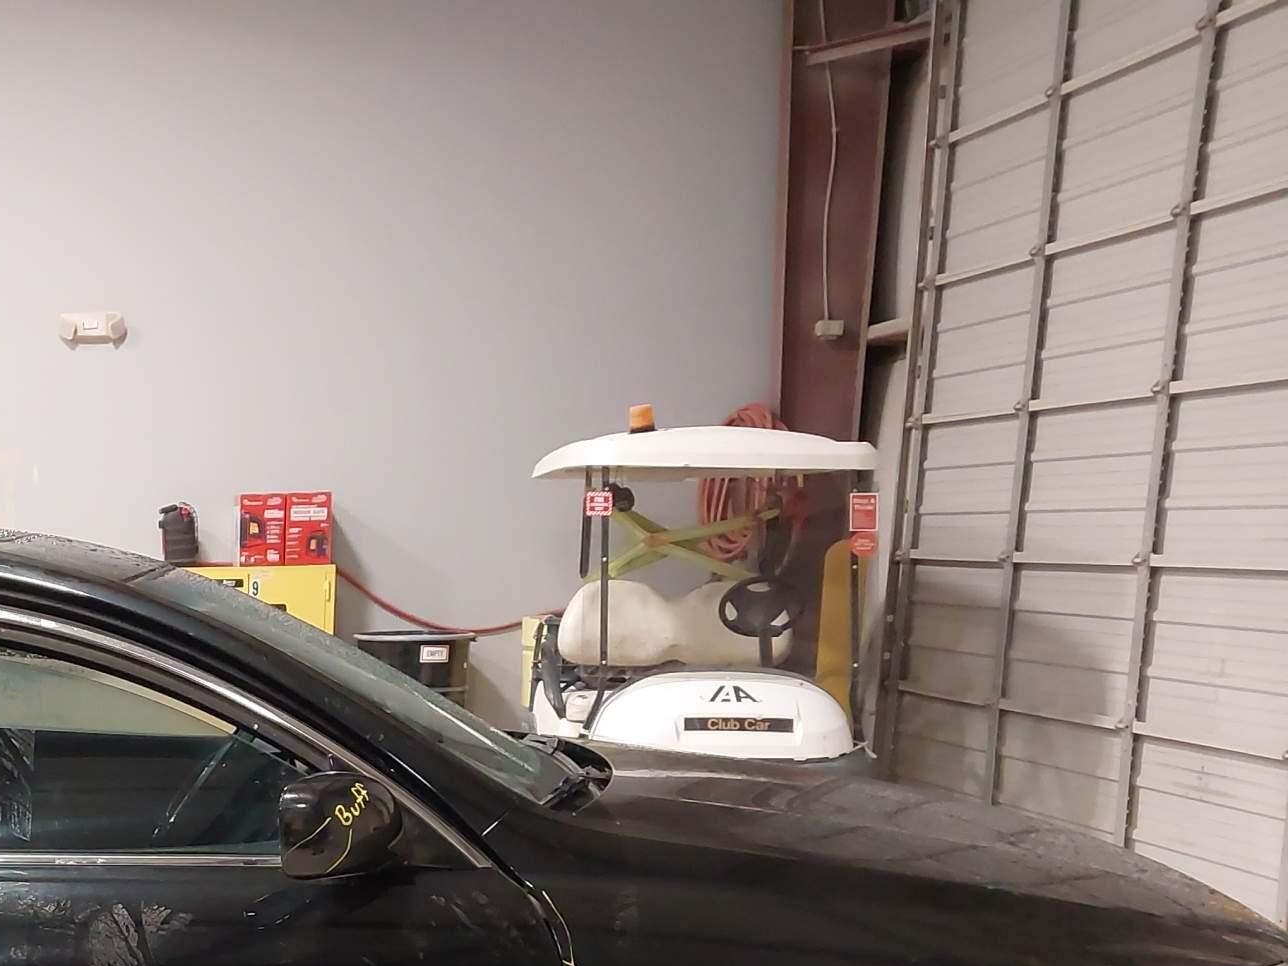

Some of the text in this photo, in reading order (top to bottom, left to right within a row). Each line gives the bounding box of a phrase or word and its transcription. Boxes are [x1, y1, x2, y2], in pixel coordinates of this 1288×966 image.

[252, 581, 260, 596] 9
[706, 718, 771, 731] Club Car
[334, 782, 369, 826] Buff
